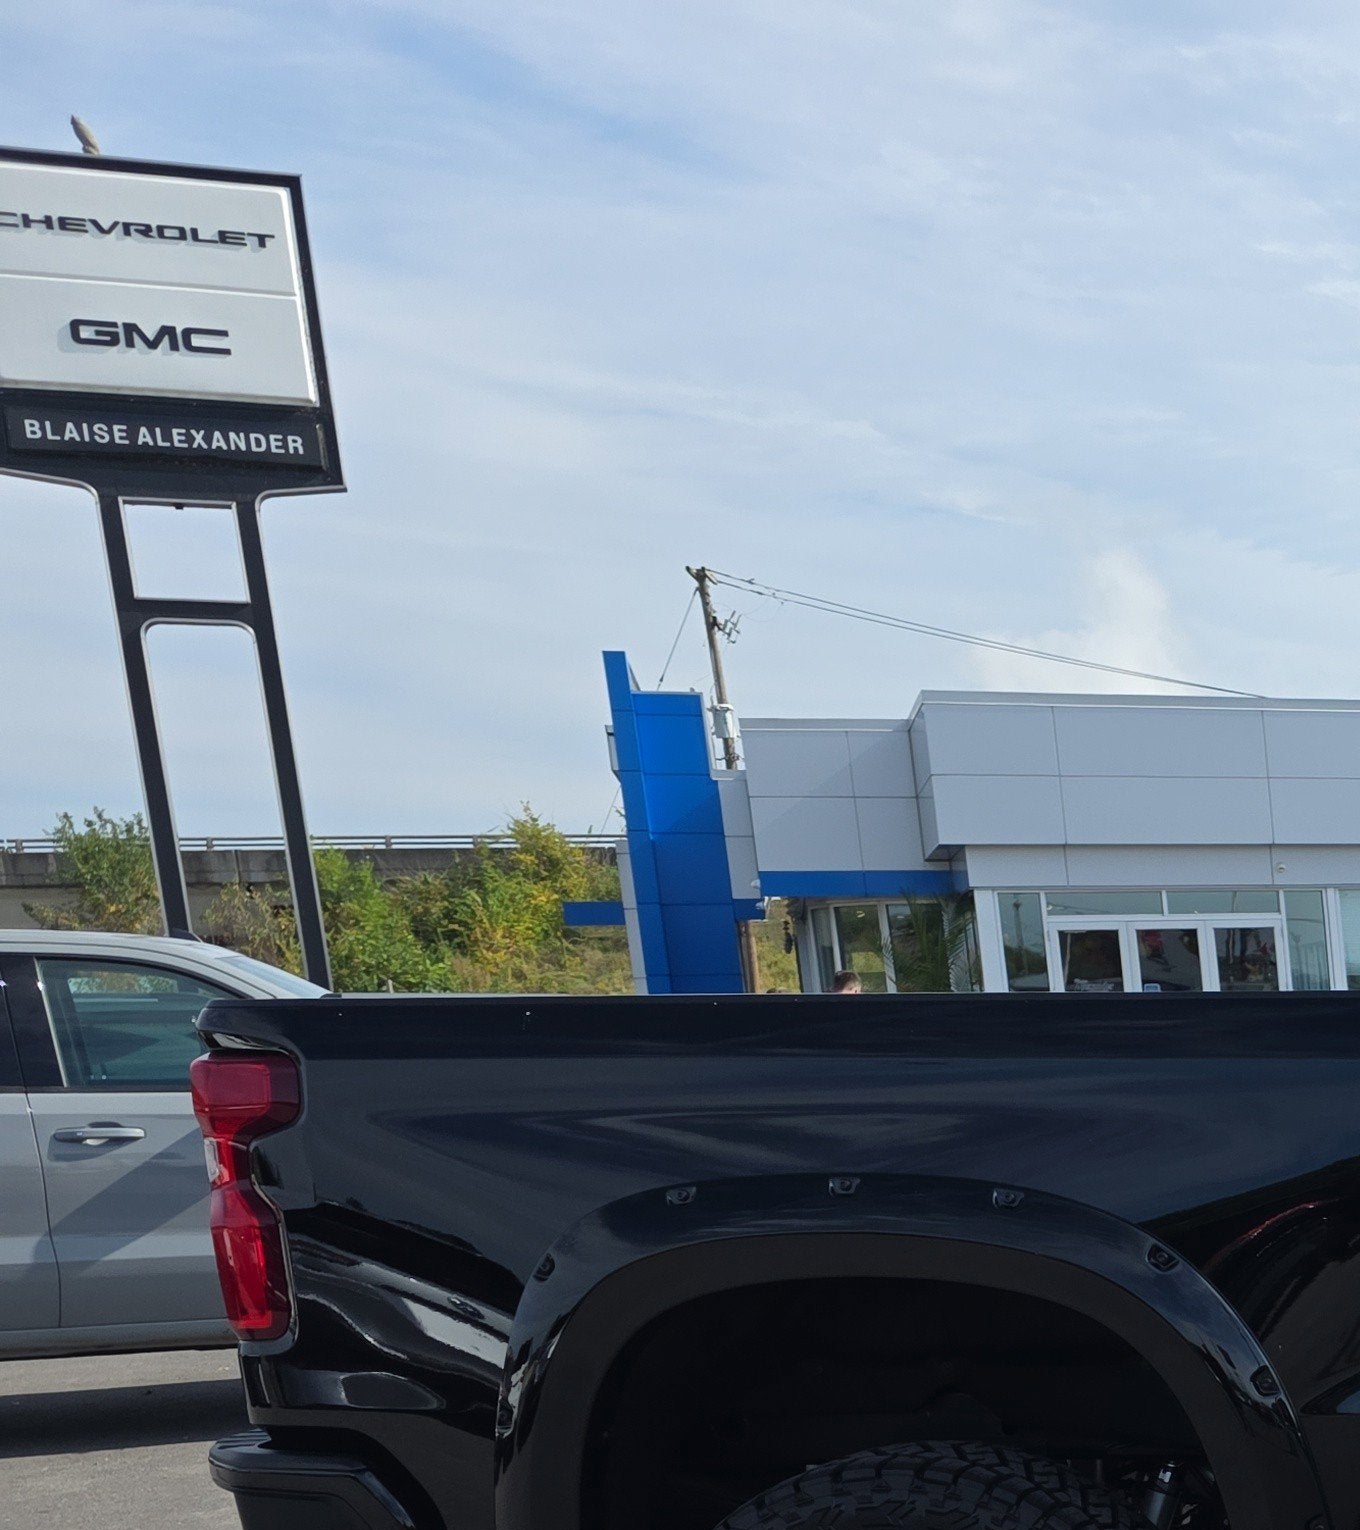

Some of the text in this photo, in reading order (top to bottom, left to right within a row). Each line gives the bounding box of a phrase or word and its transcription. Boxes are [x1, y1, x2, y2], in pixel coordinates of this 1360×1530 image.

[0, 211, 275, 249] CHEVROLET
[69, 318, 232, 356] GMC
[23, 418, 305, 455] BLAISE ALEXANDER
